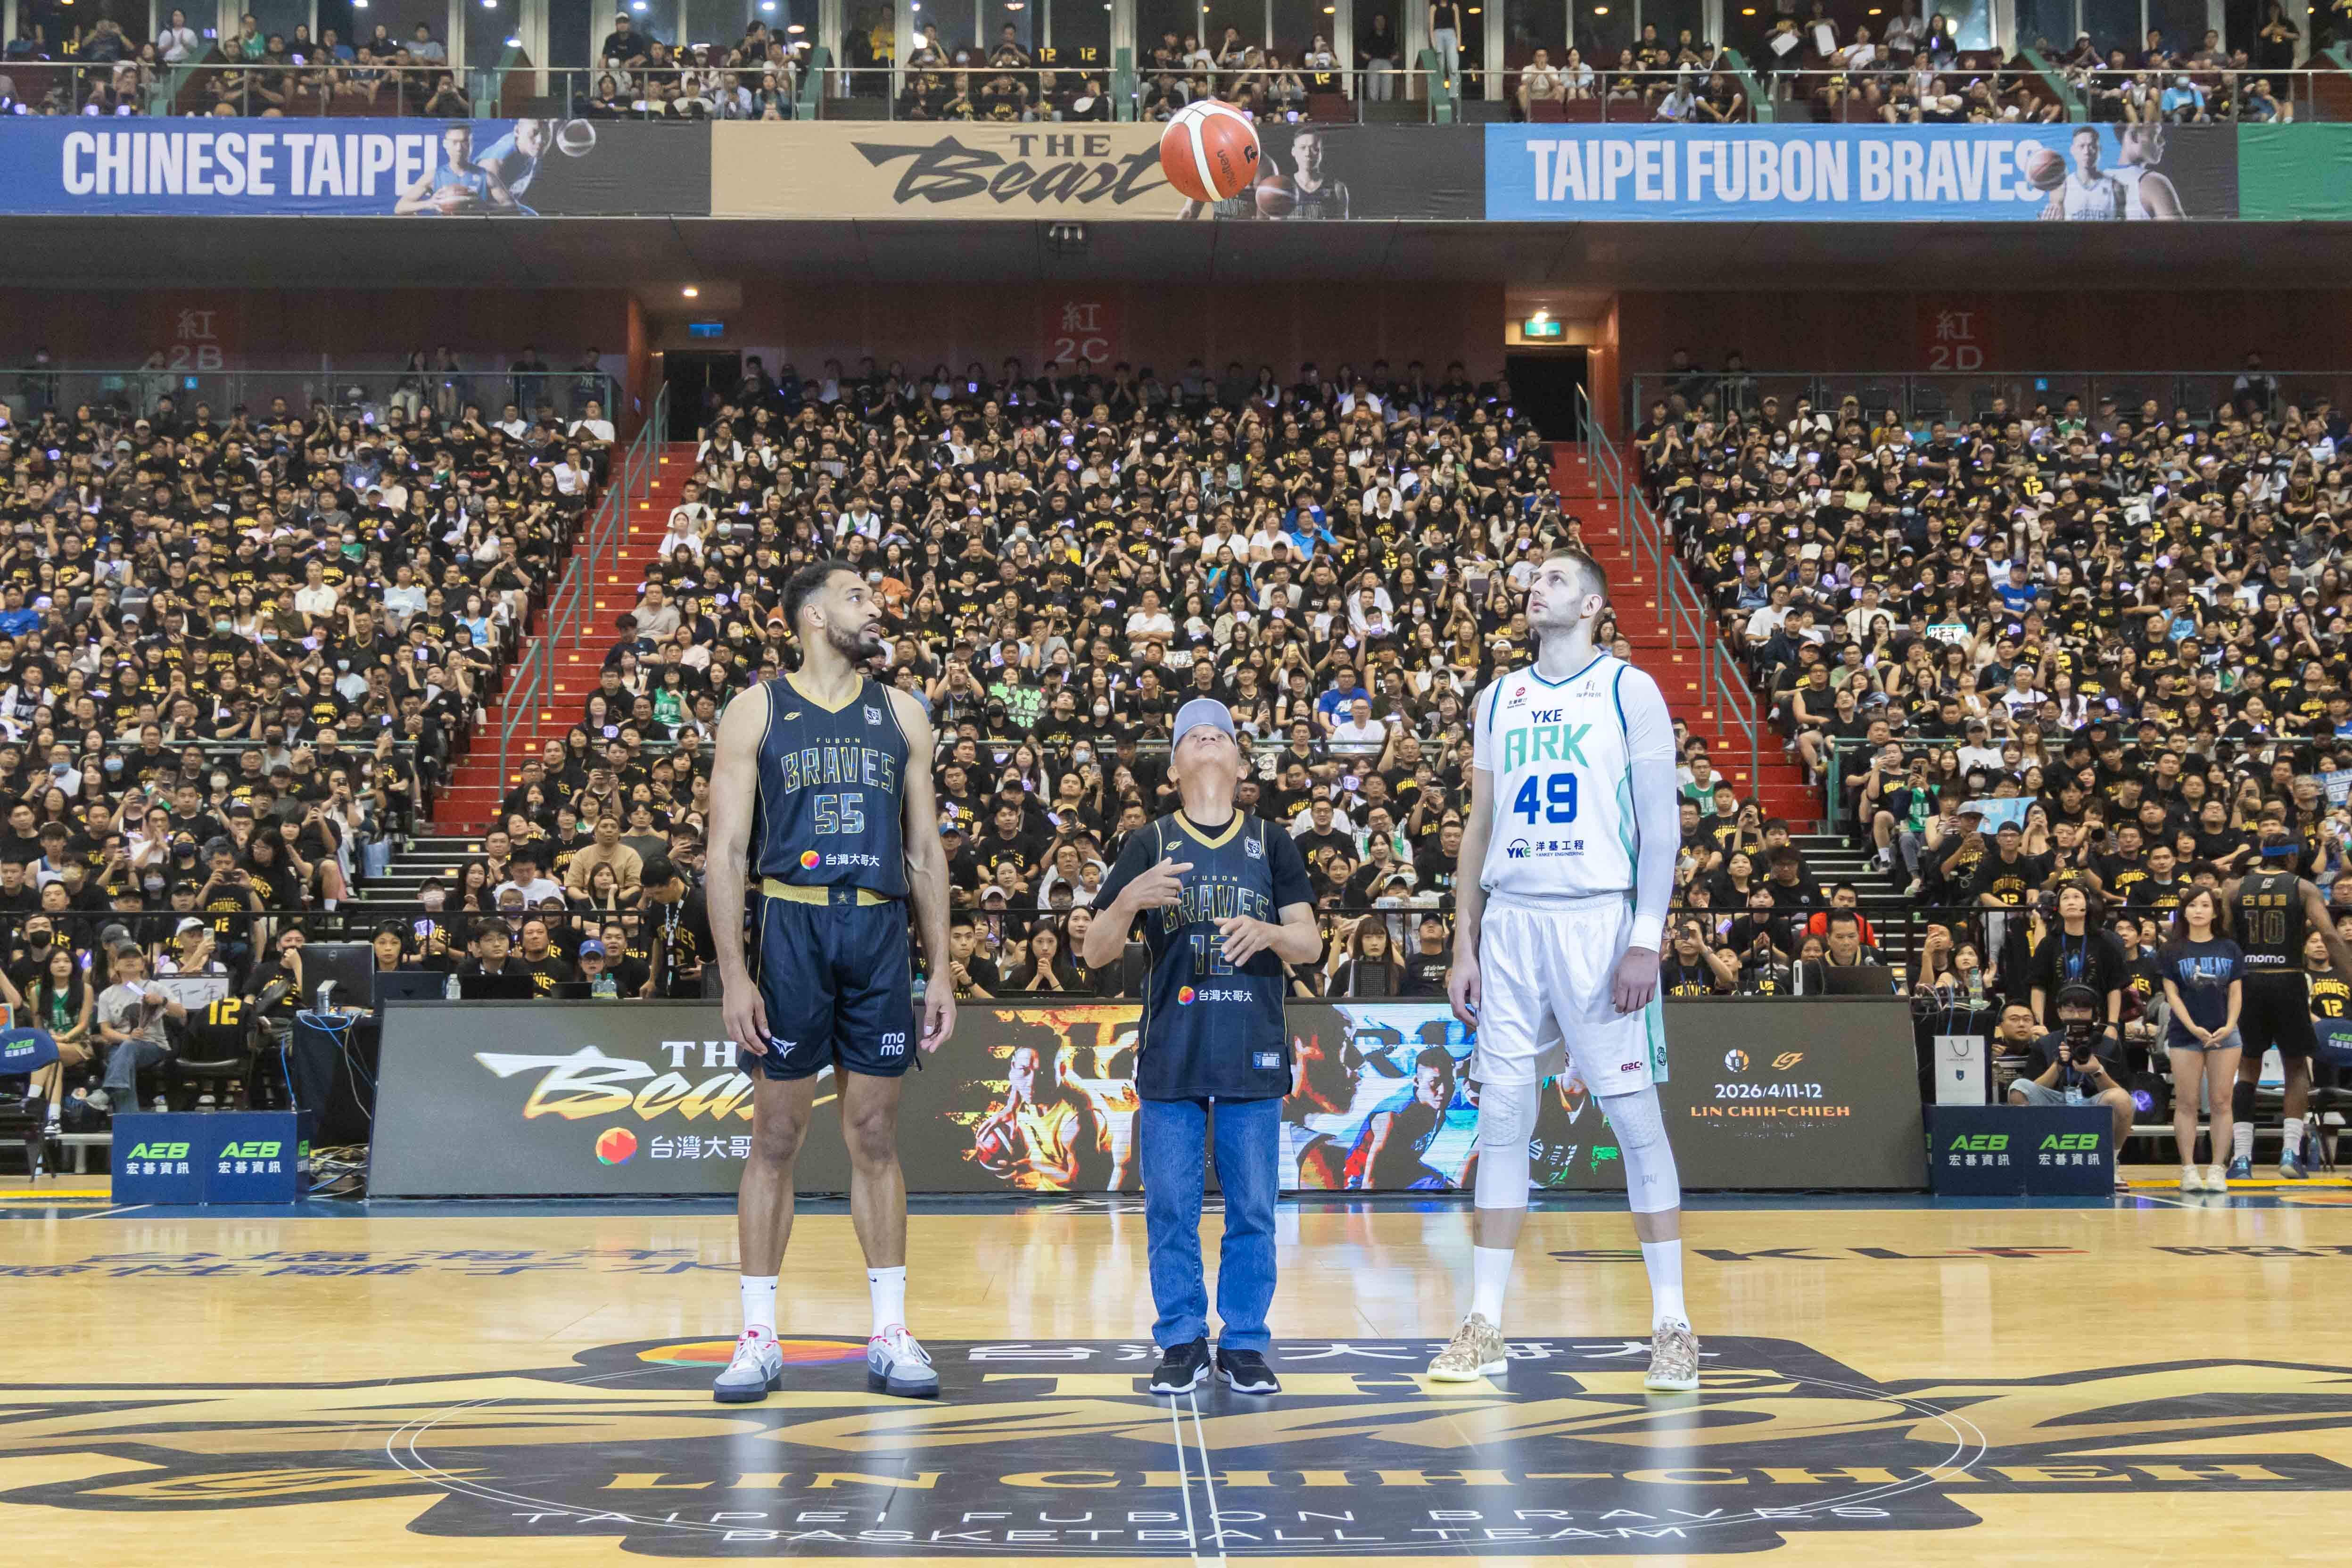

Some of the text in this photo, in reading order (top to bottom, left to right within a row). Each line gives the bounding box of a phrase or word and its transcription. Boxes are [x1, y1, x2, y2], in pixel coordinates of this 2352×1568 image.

[1010, 133, 1111, 157] THE
[63, 131, 437, 197] CHINESE TAIPEI
[850, 135, 1166, 205] Beast
[1527, 139, 2044, 202] TAIPEI FUBON BRAVES
[170, 346, 223, 371] 2B
[1054, 338, 1110, 363] 2C
[1929, 346, 1983, 371] 2D
[1531, 709, 1564, 724] YKE
[1504, 723, 1593, 775] ARK
[781, 746, 895, 795] BRAVES
[1513, 772, 1578, 825] 49
[814, 793, 865, 834] 55
[1506, 847, 1531, 859] YKE
[1535, 840, 1585, 851] 洋基工程
[825, 853, 880, 867] 台灣大哥大
[2245, 909, 2286, 944] 10
[2244, 954, 2286, 964] momo
[1198, 989, 1253, 1002] 台灣大哥大
[209, 997, 242, 1025] 12
[2321, 999, 2343, 1017] 12
[883, 1032, 906, 1044] mo
[661, 1041, 737, 1068] TH
[880, 1044, 905, 1056] mo
[473, 1045, 837, 1121] Bea
[1714, 1083, 1823, 1098] 2026/4/11-12
[1690, 1106, 1850, 1117] LIN CHIH-CHIEH
[650, 1134, 753, 1159] 台灣大哥
[125, 1161, 190, 1175] 宏碁資訊
[218, 1160, 282, 1174] 宏碁資訊
[1948, 1153, 2010, 1166] 宏碁資訊
[2038, 1153, 2101, 1165] 宏碁資訊
[601, 1464, 2296, 1490] LIN CHIH-CHIEH
[511, 1507, 1890, 1523] TAIPEI FUBON BRAVES
[720, 1527, 1690, 1542] BASKETBALL TEAM
